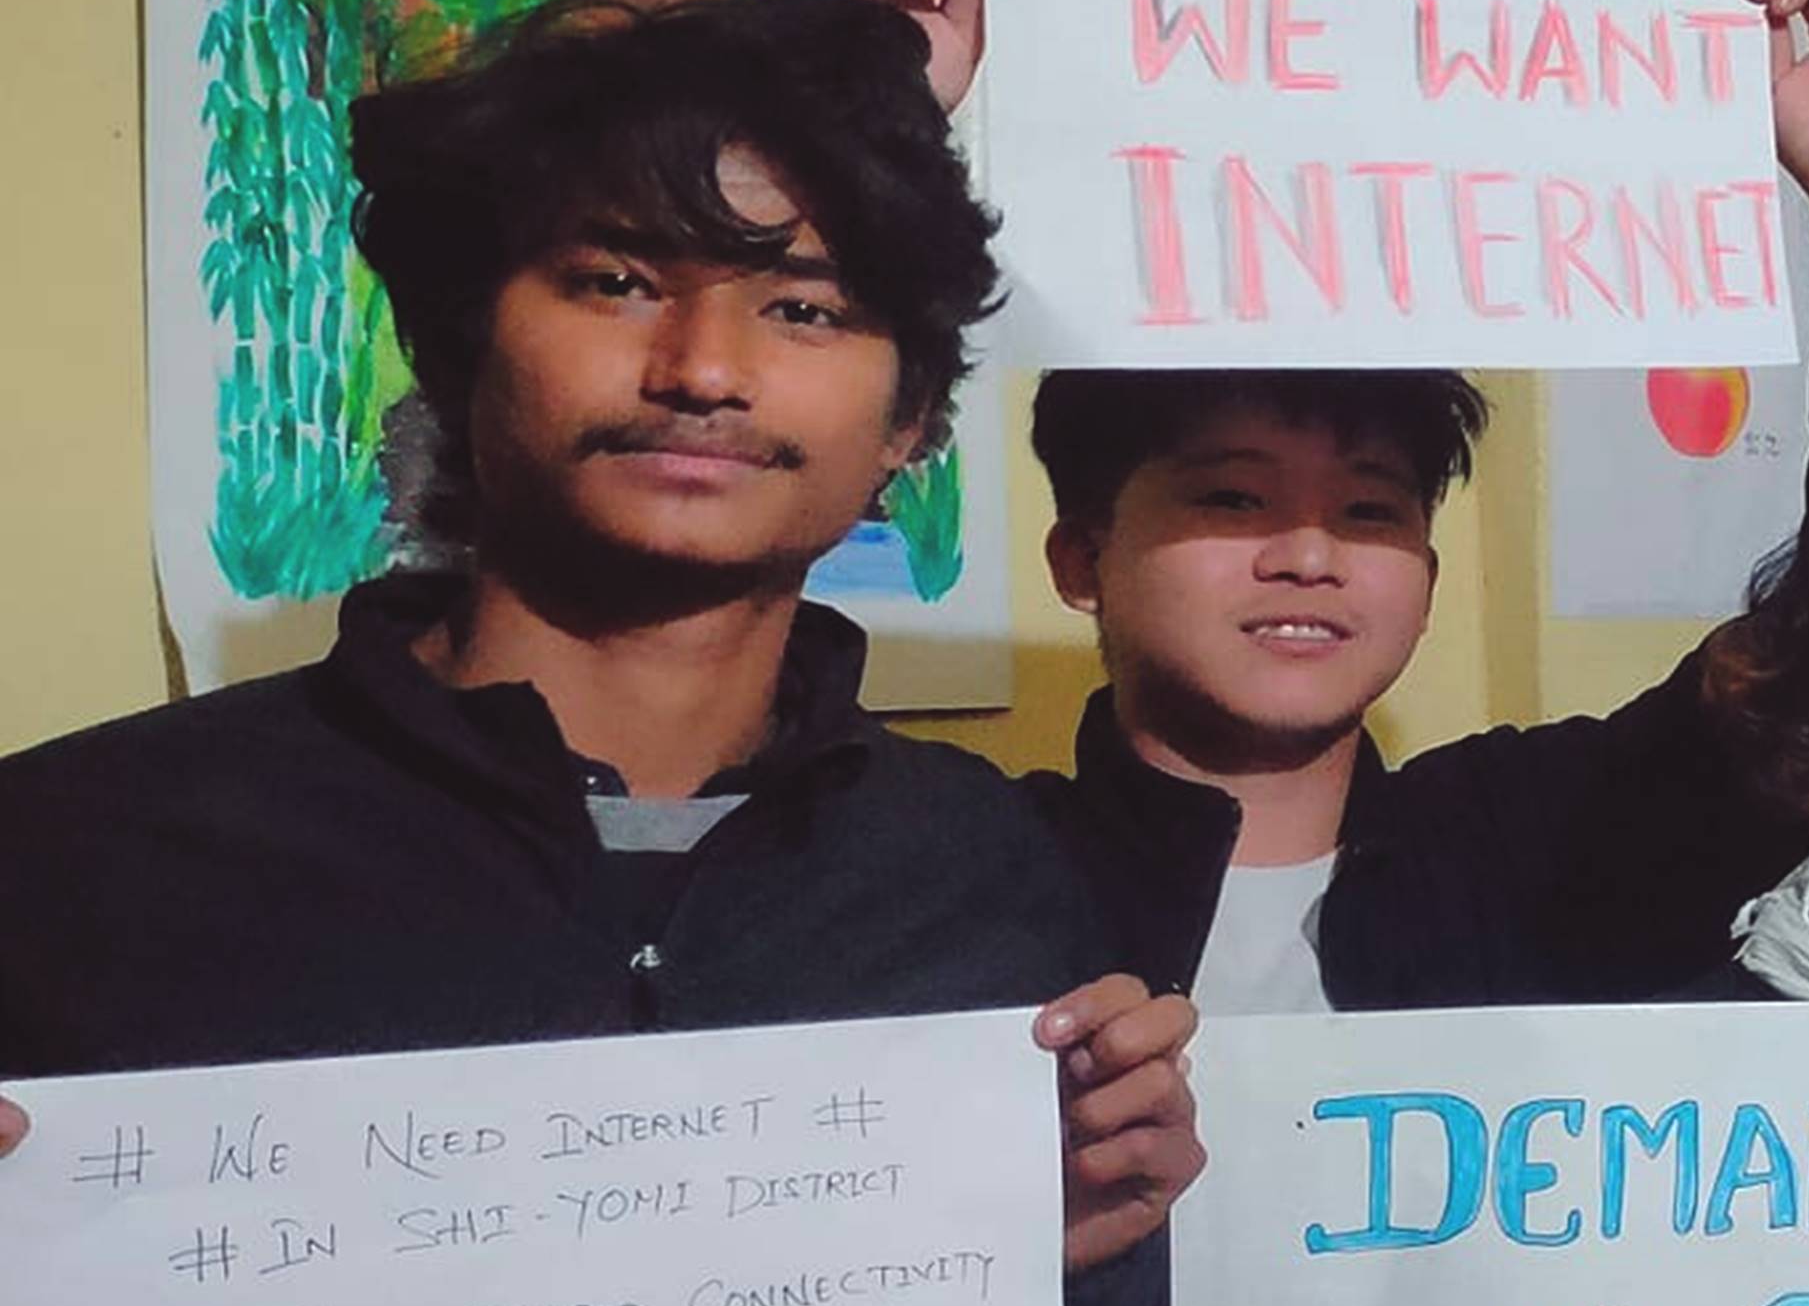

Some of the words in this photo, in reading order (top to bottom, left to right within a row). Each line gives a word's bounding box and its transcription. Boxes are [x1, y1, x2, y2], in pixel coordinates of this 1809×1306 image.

[1112, 144, 1778, 327] INTERNET
[209, 1113, 290, 1184] WE
[364, 1110, 507, 1180] NEED
[541, 1097, 776, 1159] INTERNET
[259, 1217, 336, 1276] IN
[725, 1163, 906, 1218] DISTRICT
